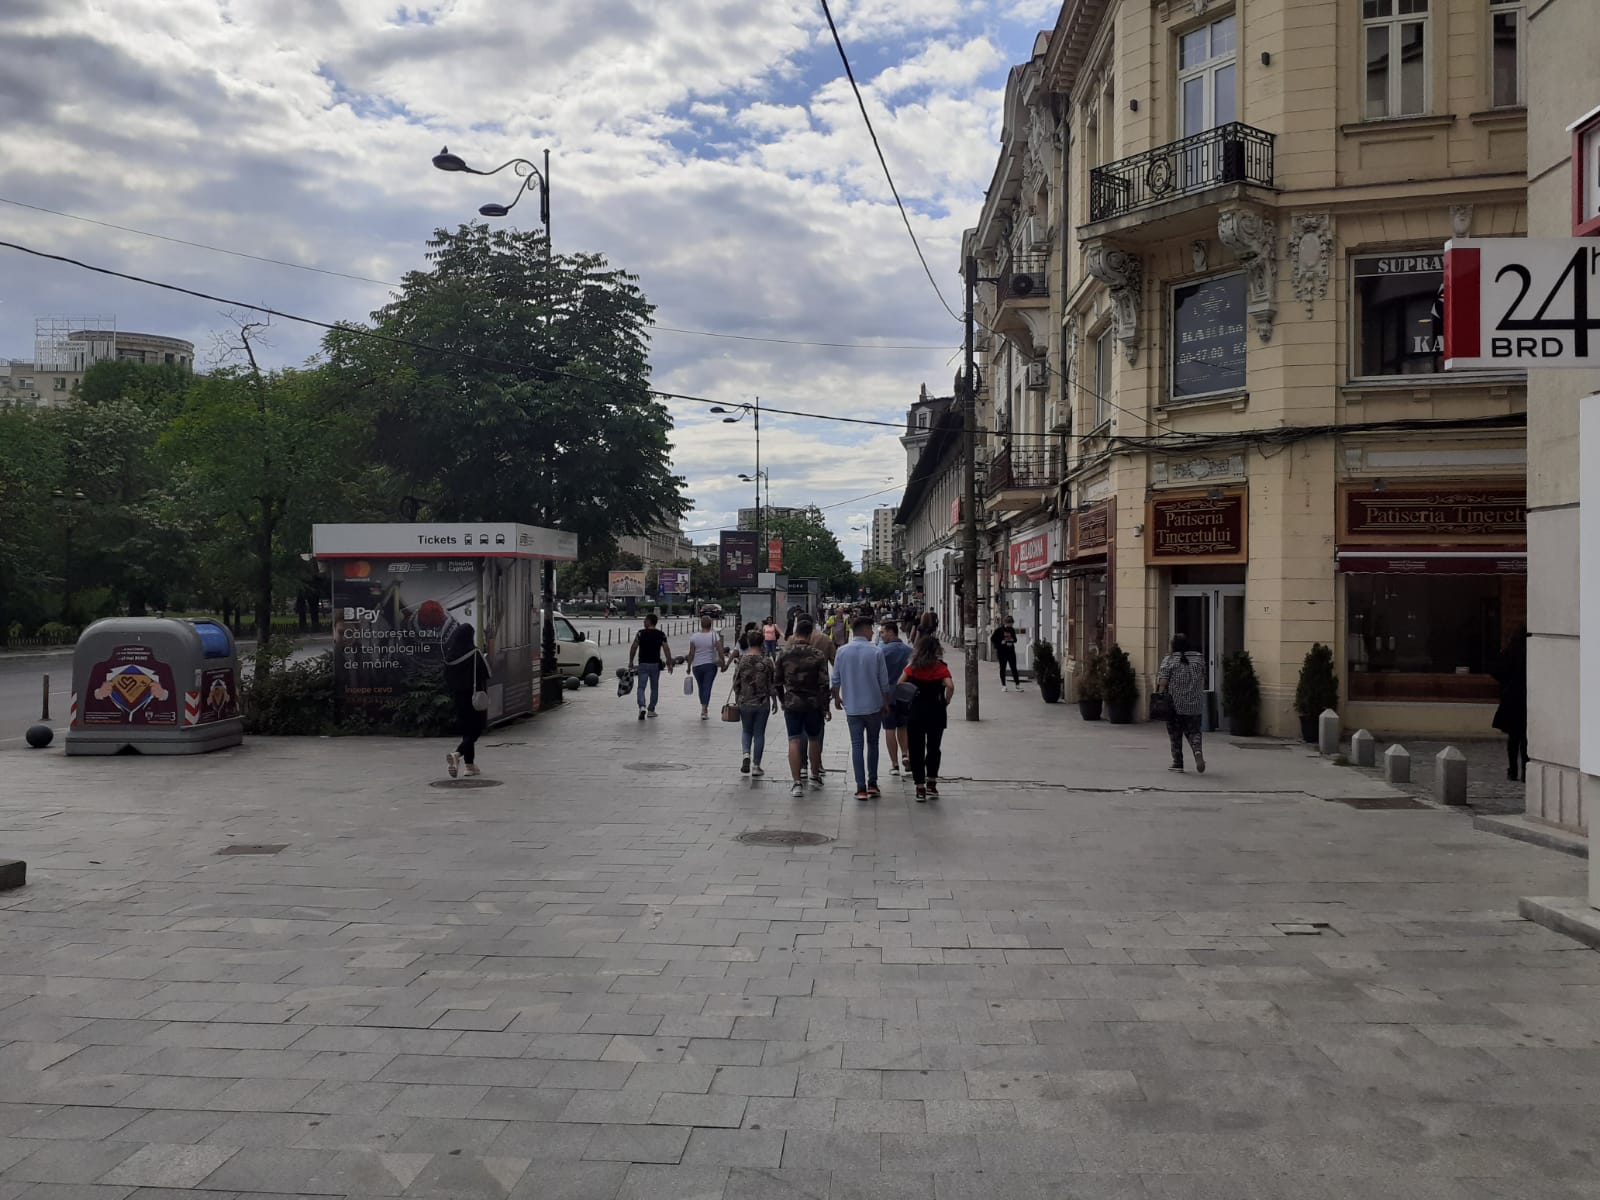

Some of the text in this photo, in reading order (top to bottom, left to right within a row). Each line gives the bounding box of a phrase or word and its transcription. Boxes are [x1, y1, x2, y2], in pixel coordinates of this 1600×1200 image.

[1378, 256, 1444, 273] SUPRA
[1491, 337, 1564, 358] BRD
[1165, 511, 1224, 528] Patiseria
[1366, 507, 1445, 523] Patiseria
[417, 535, 457, 545] Tickets
[1156, 527, 1232, 544] Tineretului
[343, 642, 431, 656] cu tehnologiile
[343, 659, 360, 670] de
